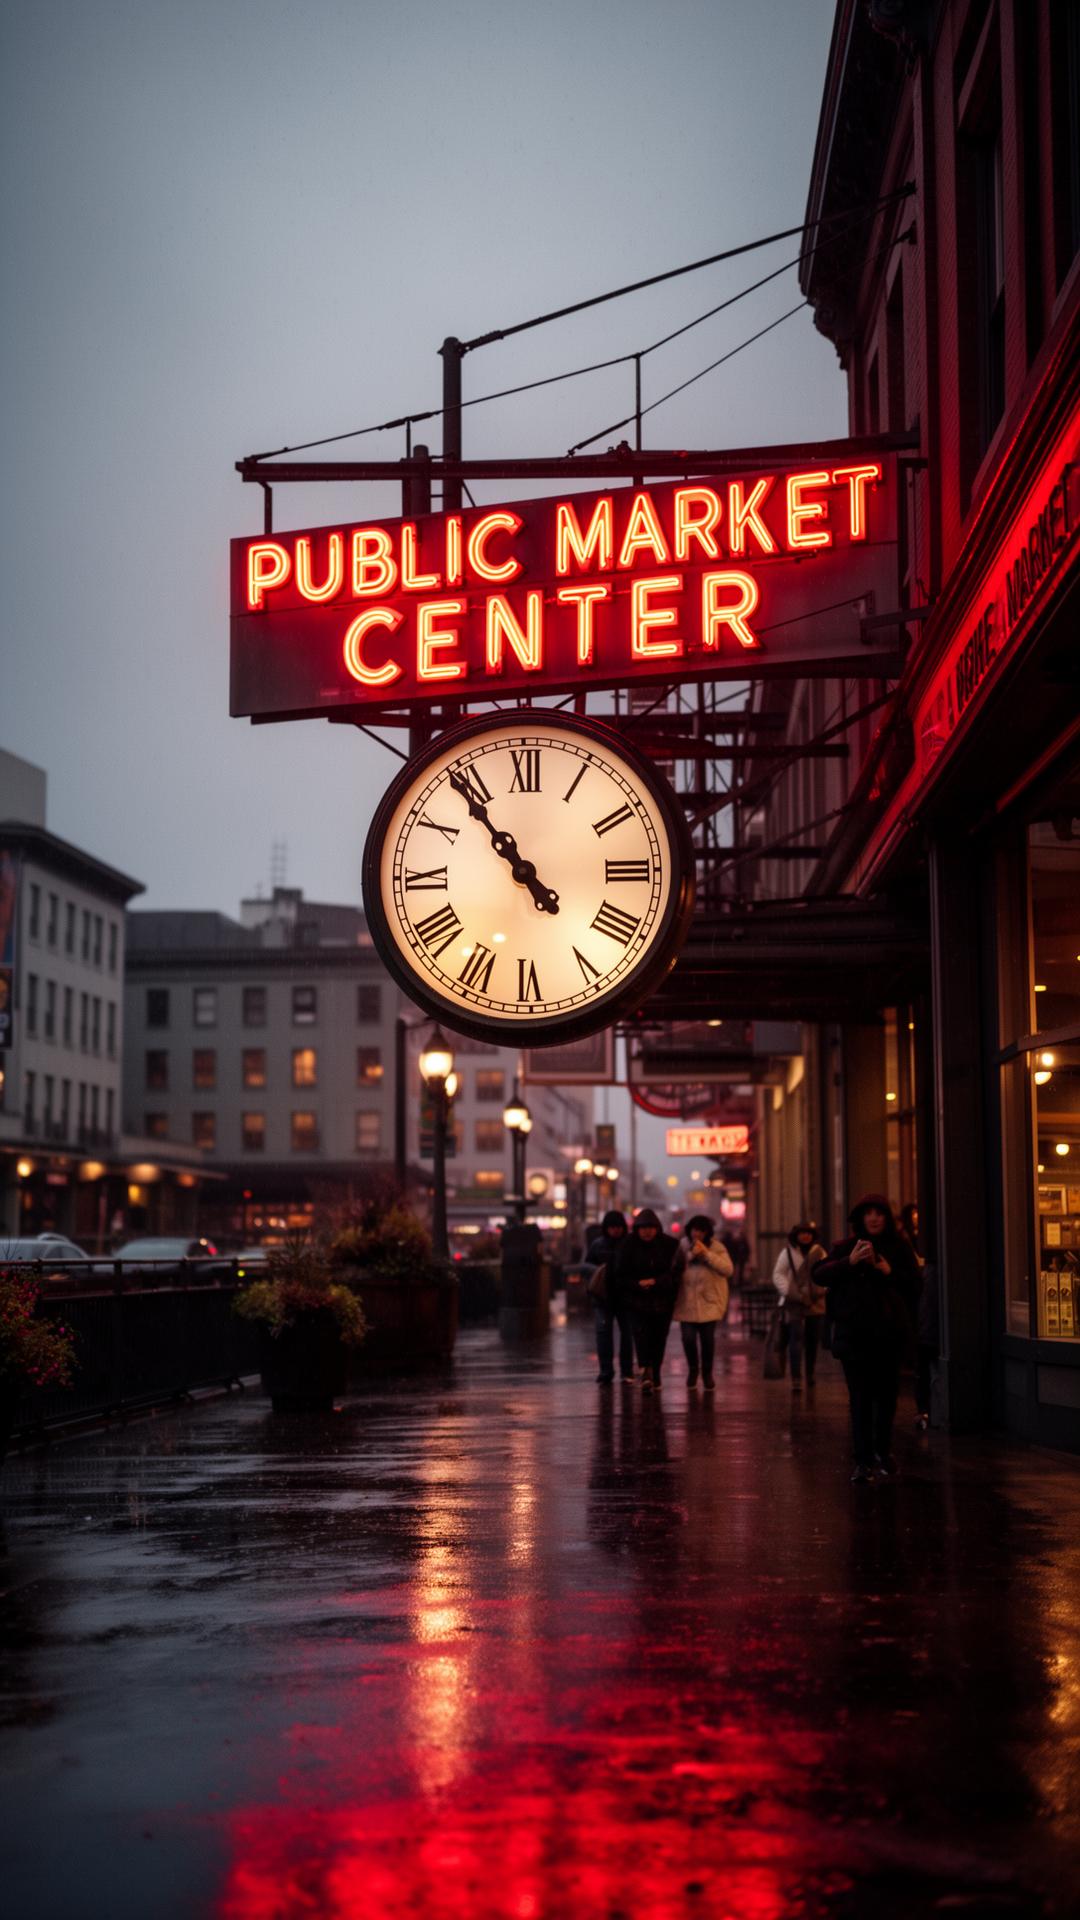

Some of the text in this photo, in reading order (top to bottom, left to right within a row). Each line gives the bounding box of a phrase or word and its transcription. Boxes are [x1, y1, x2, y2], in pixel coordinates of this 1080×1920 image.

[247, 463, 881, 611] PUBLIC MARKET
[343, 569, 760, 687] CENTER
[508, 749, 542, 793] XII
[563, 762, 590, 803] I
[417, 812, 460, 845] X
[592, 802, 636, 838] II
[605, 858, 650, 884] III
[572, 945, 602, 985] V
